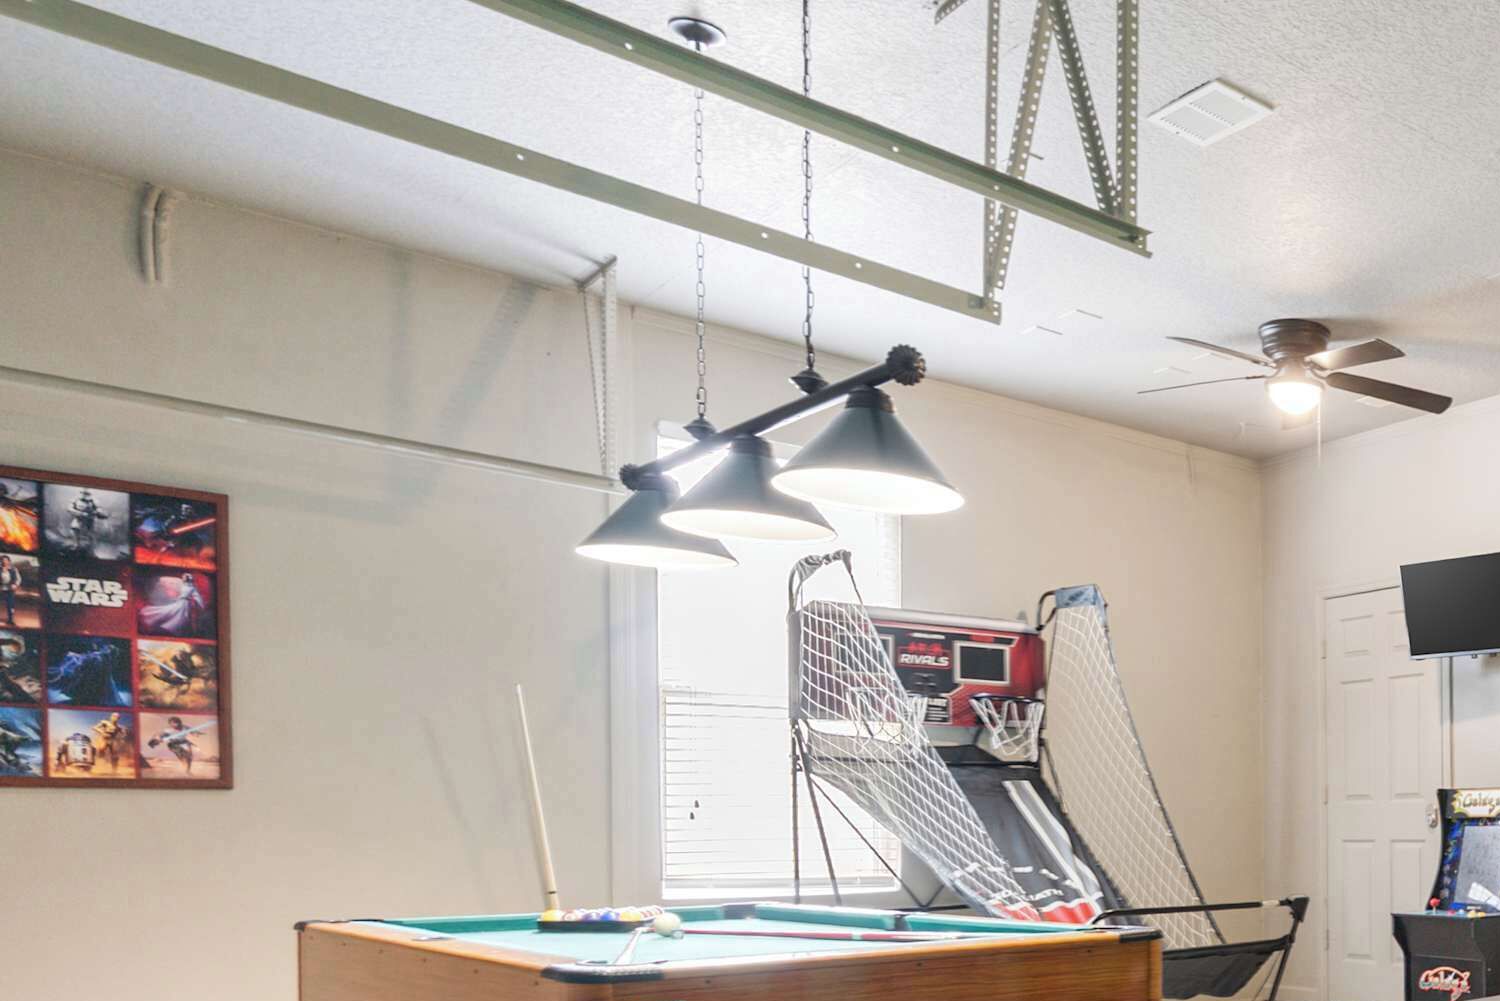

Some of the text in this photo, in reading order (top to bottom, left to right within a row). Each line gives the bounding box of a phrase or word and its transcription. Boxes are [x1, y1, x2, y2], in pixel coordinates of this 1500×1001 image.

[46, 576, 128, 596] STAR
[48, 589, 128, 608] WARS
[900, 653, 950, 667] RIVALS
